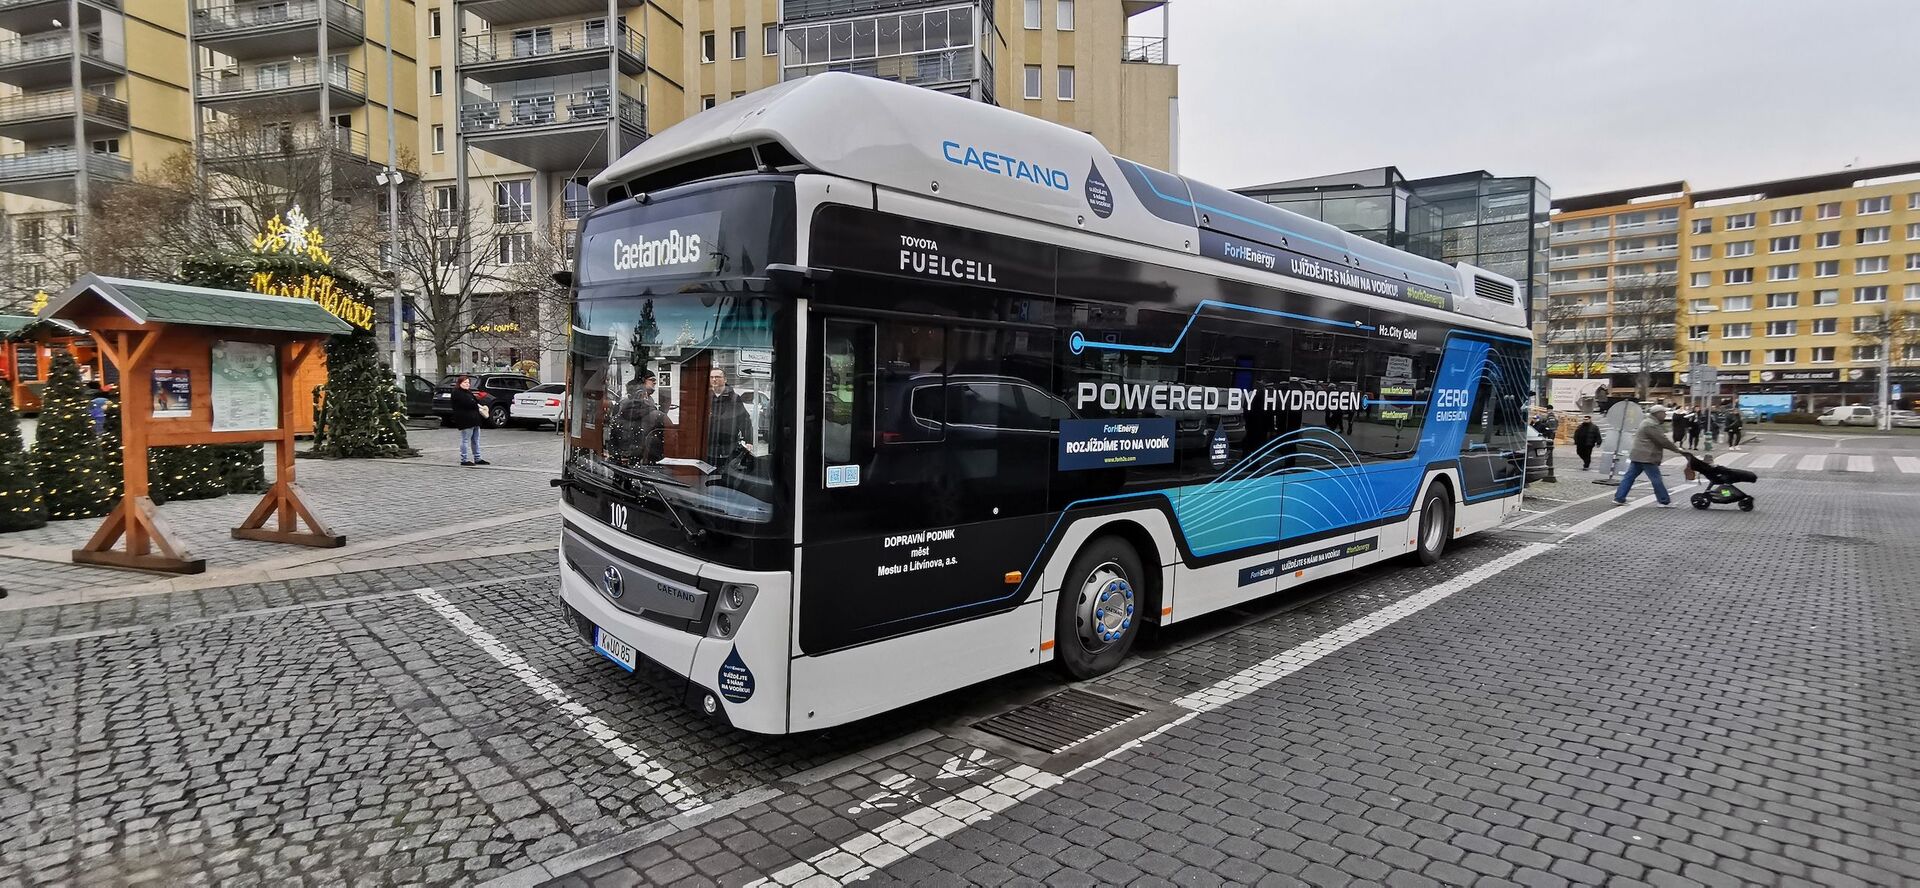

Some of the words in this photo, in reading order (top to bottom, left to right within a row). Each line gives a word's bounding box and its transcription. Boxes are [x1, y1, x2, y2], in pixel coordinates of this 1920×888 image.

[942, 140, 1069, 191] CAETANO
[614, 229, 701, 271] CaetanoBus
[900, 235, 938, 251] TOYOTA
[900, 249, 997, 283] FUELCELL
[1224, 242, 1276, 269] ForHEnergy
[1291, 258, 1333, 281] UJÍŽDĚJTE
[1333, 270, 1340, 283] S
[1340, 270, 1359, 288] NÁMI
[1360, 277, 1371, 291] NA
[1403, 328, 1418, 340] Gold
[1077, 382, 1219, 410] POWERED
[1227, 387, 1257, 411] BY
[1263, 389, 1361, 411] HYDROGEN
[1437, 388, 1469, 407] ZERO
[1436, 410, 1468, 422] EMISSION
[1103, 424, 1140, 434] ForHEnergy
[1066, 437, 1119, 454] ROZJÍŽDÍME
[1119, 439, 1131, 451] TO
[1132, 438, 1144, 450] NA
[1145, 435, 1169, 449] VODÍK
[610, 502, 628, 531] 102
[884, 531, 926, 547] DOPRAVNÍ
[926, 529, 955, 541] PODNIK
[911, 546, 930, 557] měst
[877, 564, 902, 577] Mostu
[903, 564, 908, 572] a
[909, 559, 945, 571] Litvínova,
[945, 556, 958, 566] a.s.
[657, 582, 696, 603] CAETANO
[601, 632, 608, 649] K
[621, 645, 631, 663] 85
